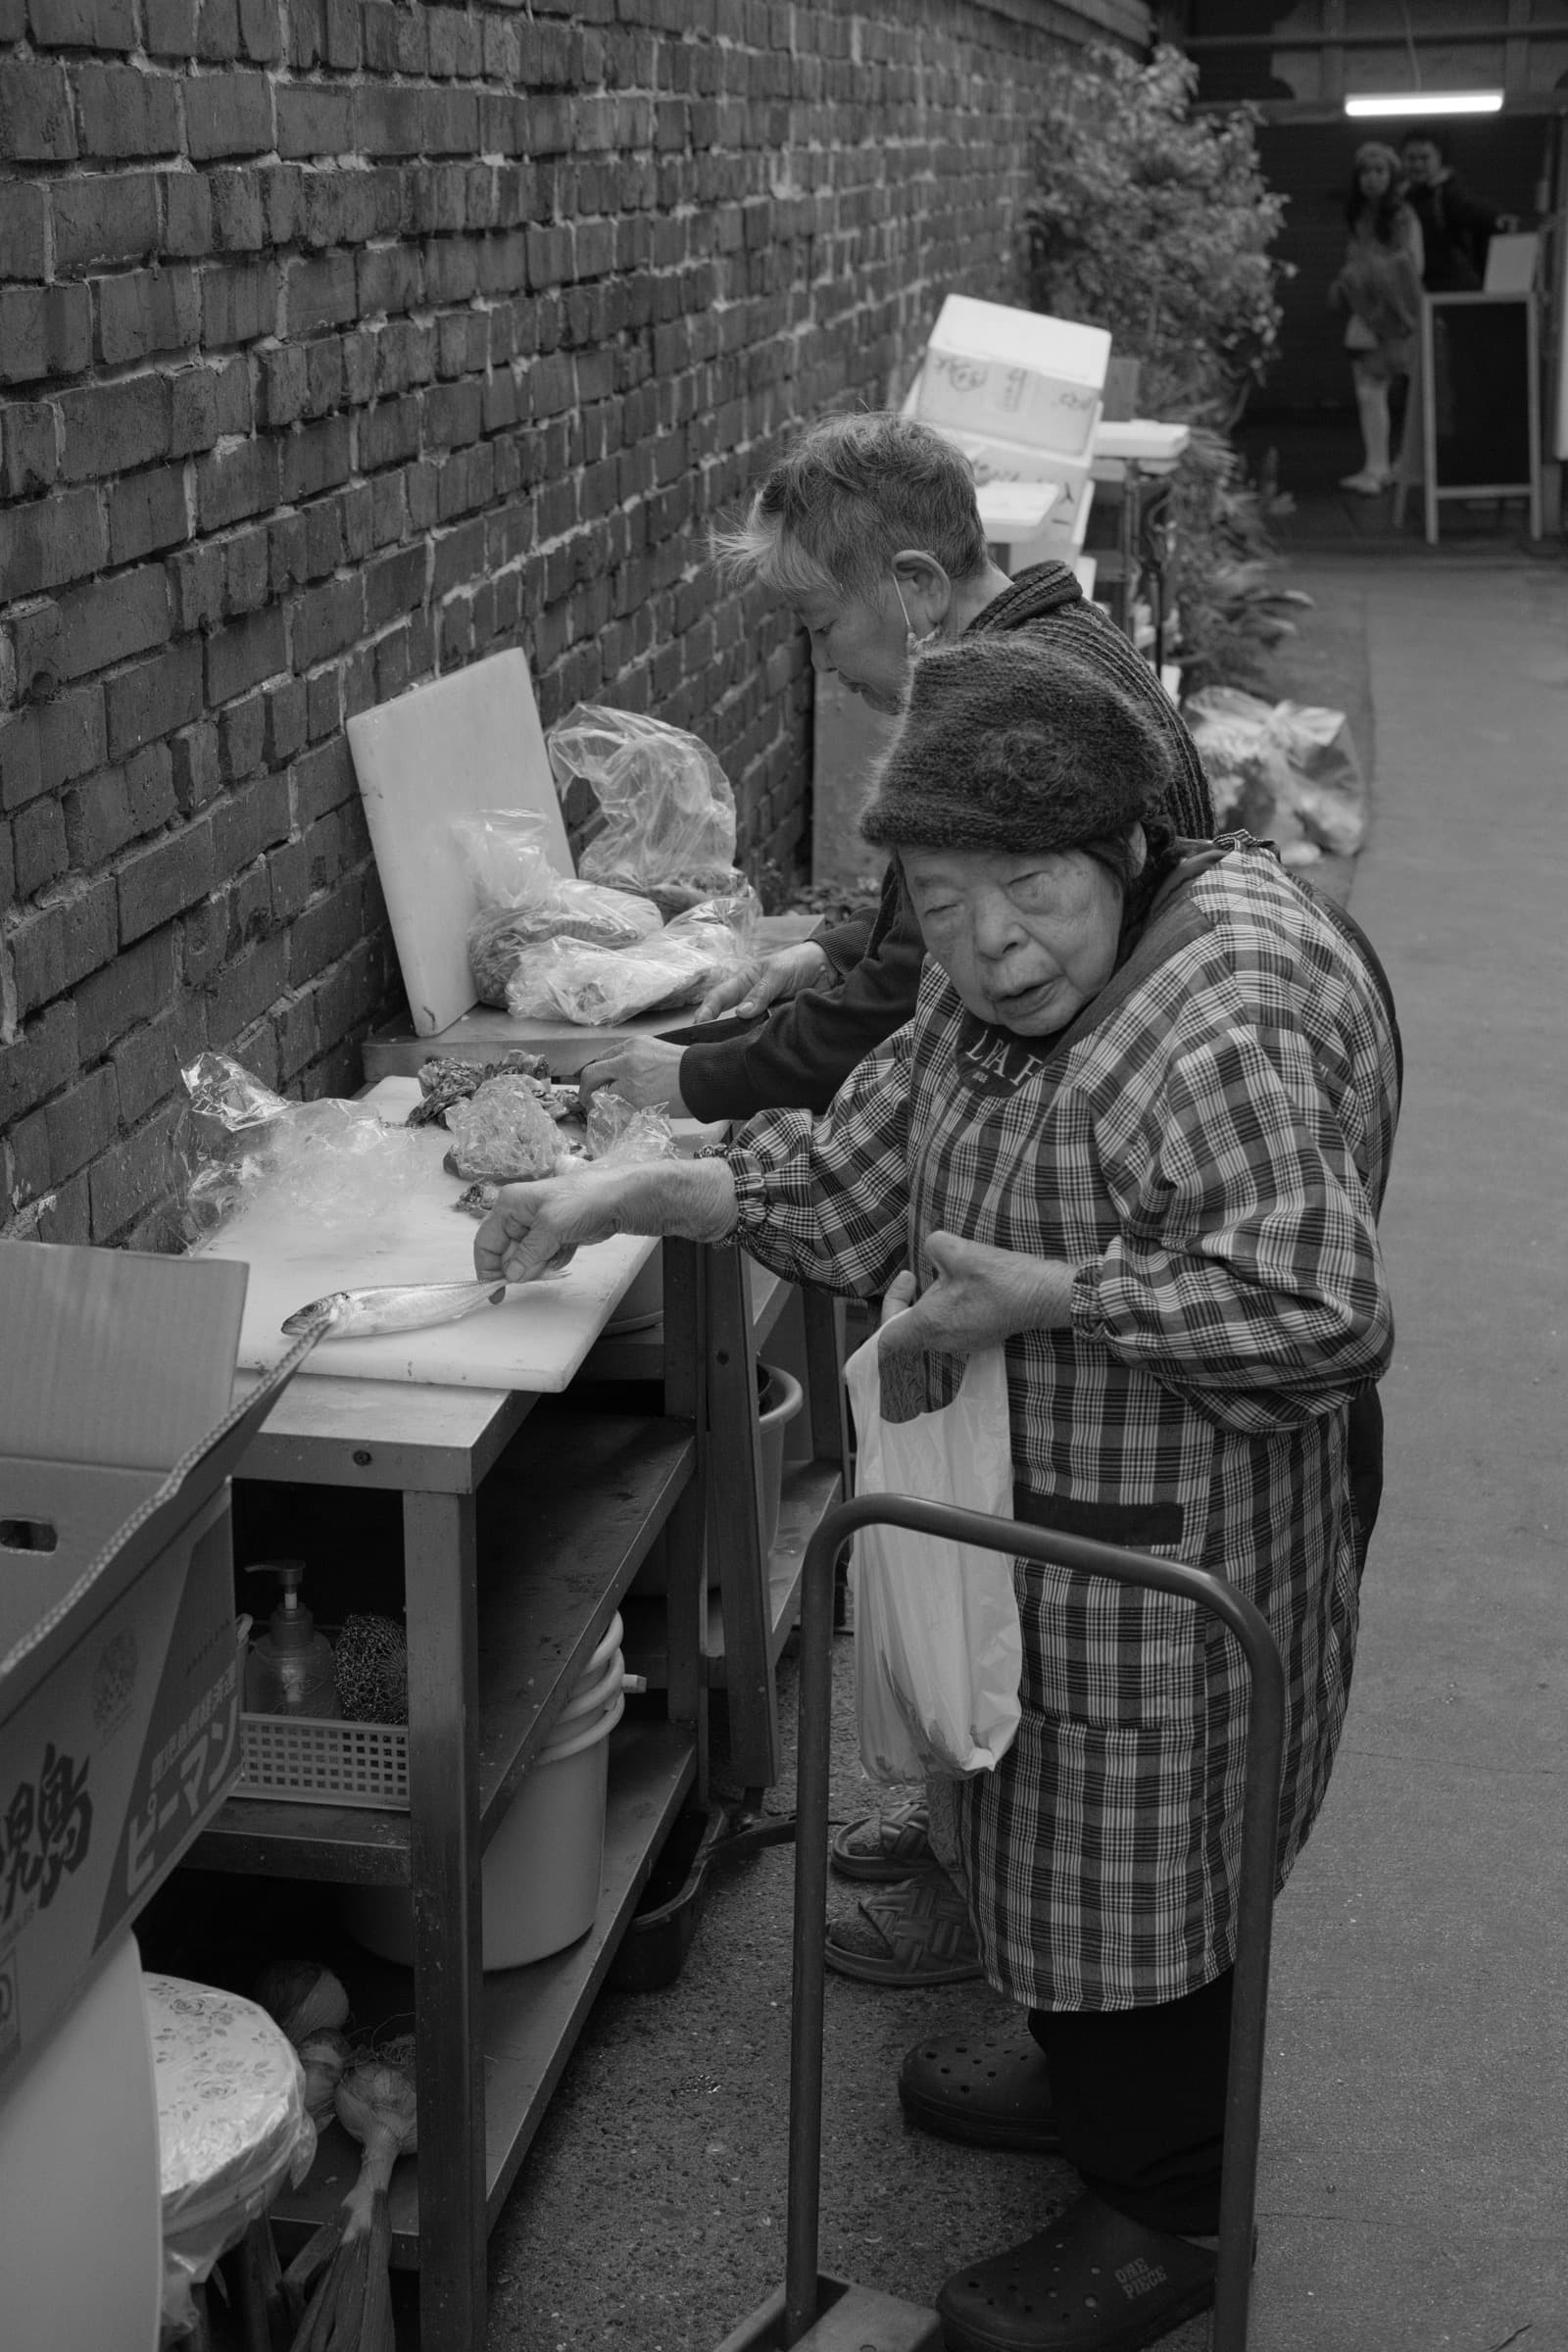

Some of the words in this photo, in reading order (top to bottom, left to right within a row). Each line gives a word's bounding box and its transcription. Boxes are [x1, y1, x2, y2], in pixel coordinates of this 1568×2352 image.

[127, 1694, 238, 1895] ピーマン
[1113, 2257, 1150, 2282] ONE
[1122, 2265, 1167, 2300] PIECE
